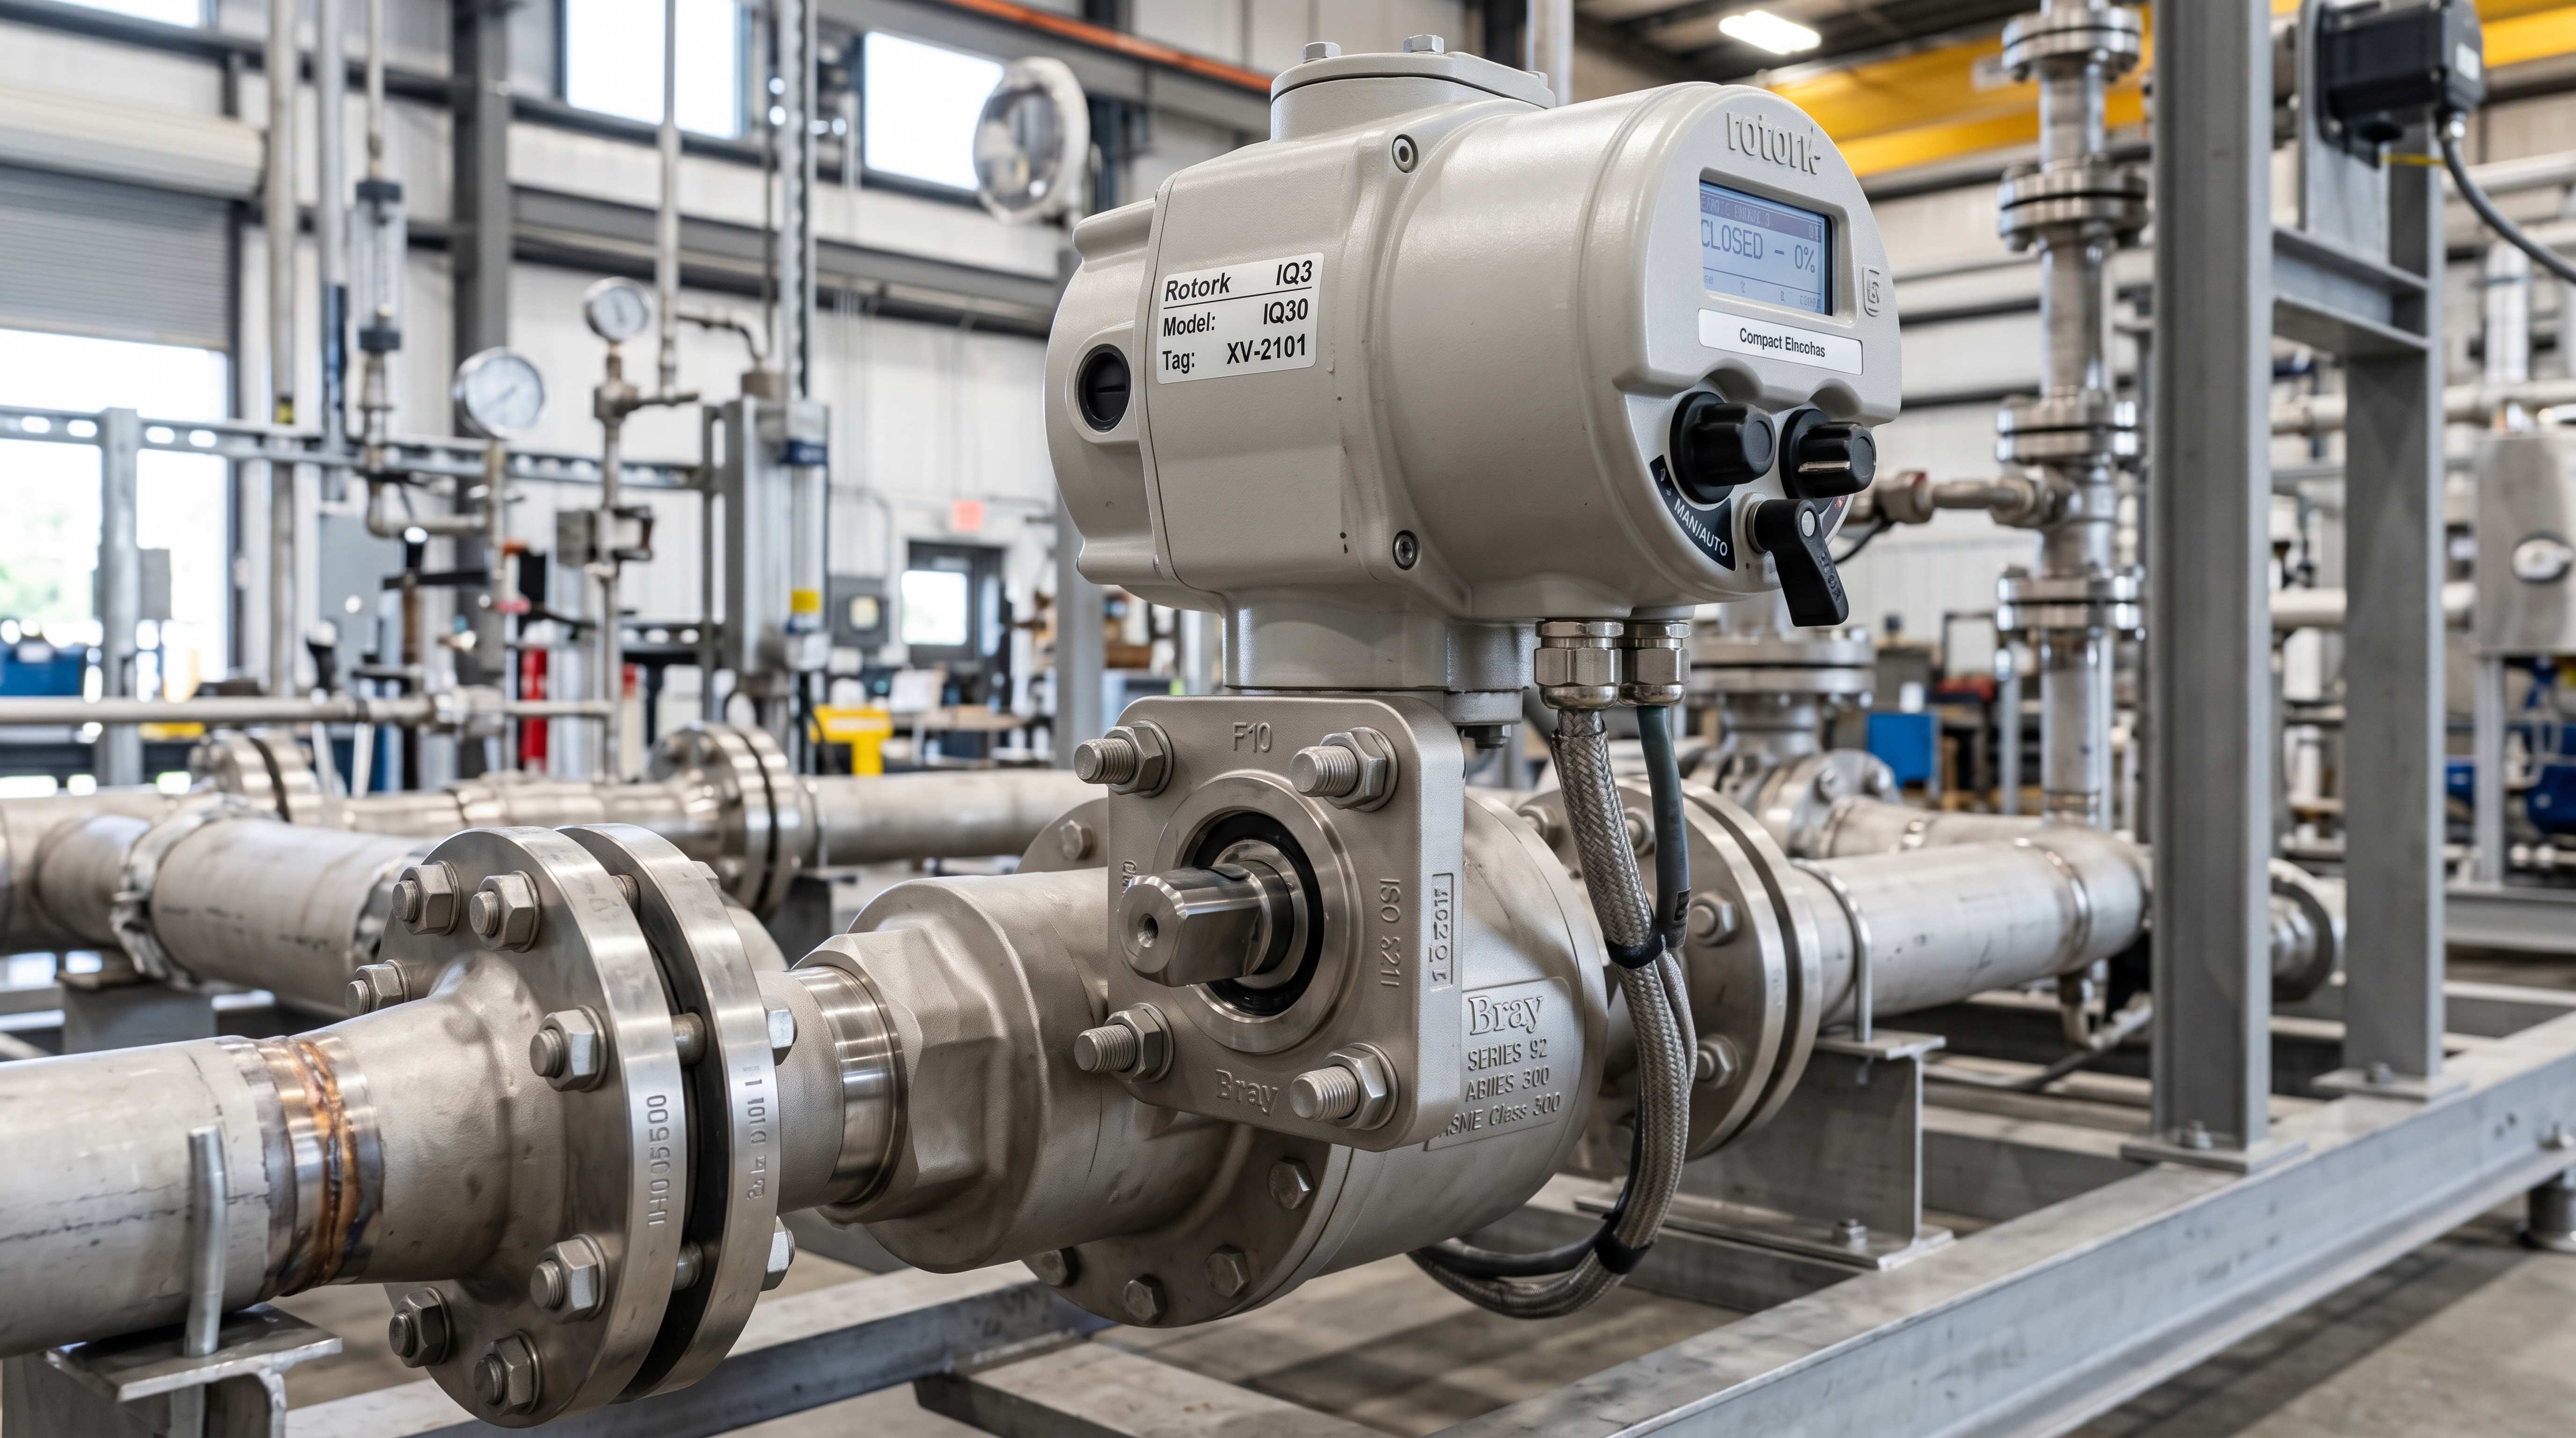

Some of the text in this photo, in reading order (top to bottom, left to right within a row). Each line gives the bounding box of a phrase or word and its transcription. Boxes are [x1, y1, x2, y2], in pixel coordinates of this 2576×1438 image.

[1701, 219, 1763, 260] CLOSED
[1794, 244, 1815, 273] 0%
[1165, 260, 1313, 302] Rotork IQ3
[1163, 298, 1309, 337] Model: IQ30
[1163, 334, 1306, 374] Tag: XV-2101
[1740, 328, 1782, 350] Compact
[1674, 498, 1728, 557] MAN/AUTO
[1233, 722, 1273, 753] F10
[1379, 879, 1401, 924] ISO
[1468, 995, 1544, 1035] Bray
[1468, 1036, 1548, 1071] SERIES 92
[1215, 1069, 1278, 1116] Bray
[1522, 1066, 1550, 1089] 300
[1489, 1103, 1527, 1127] Class
